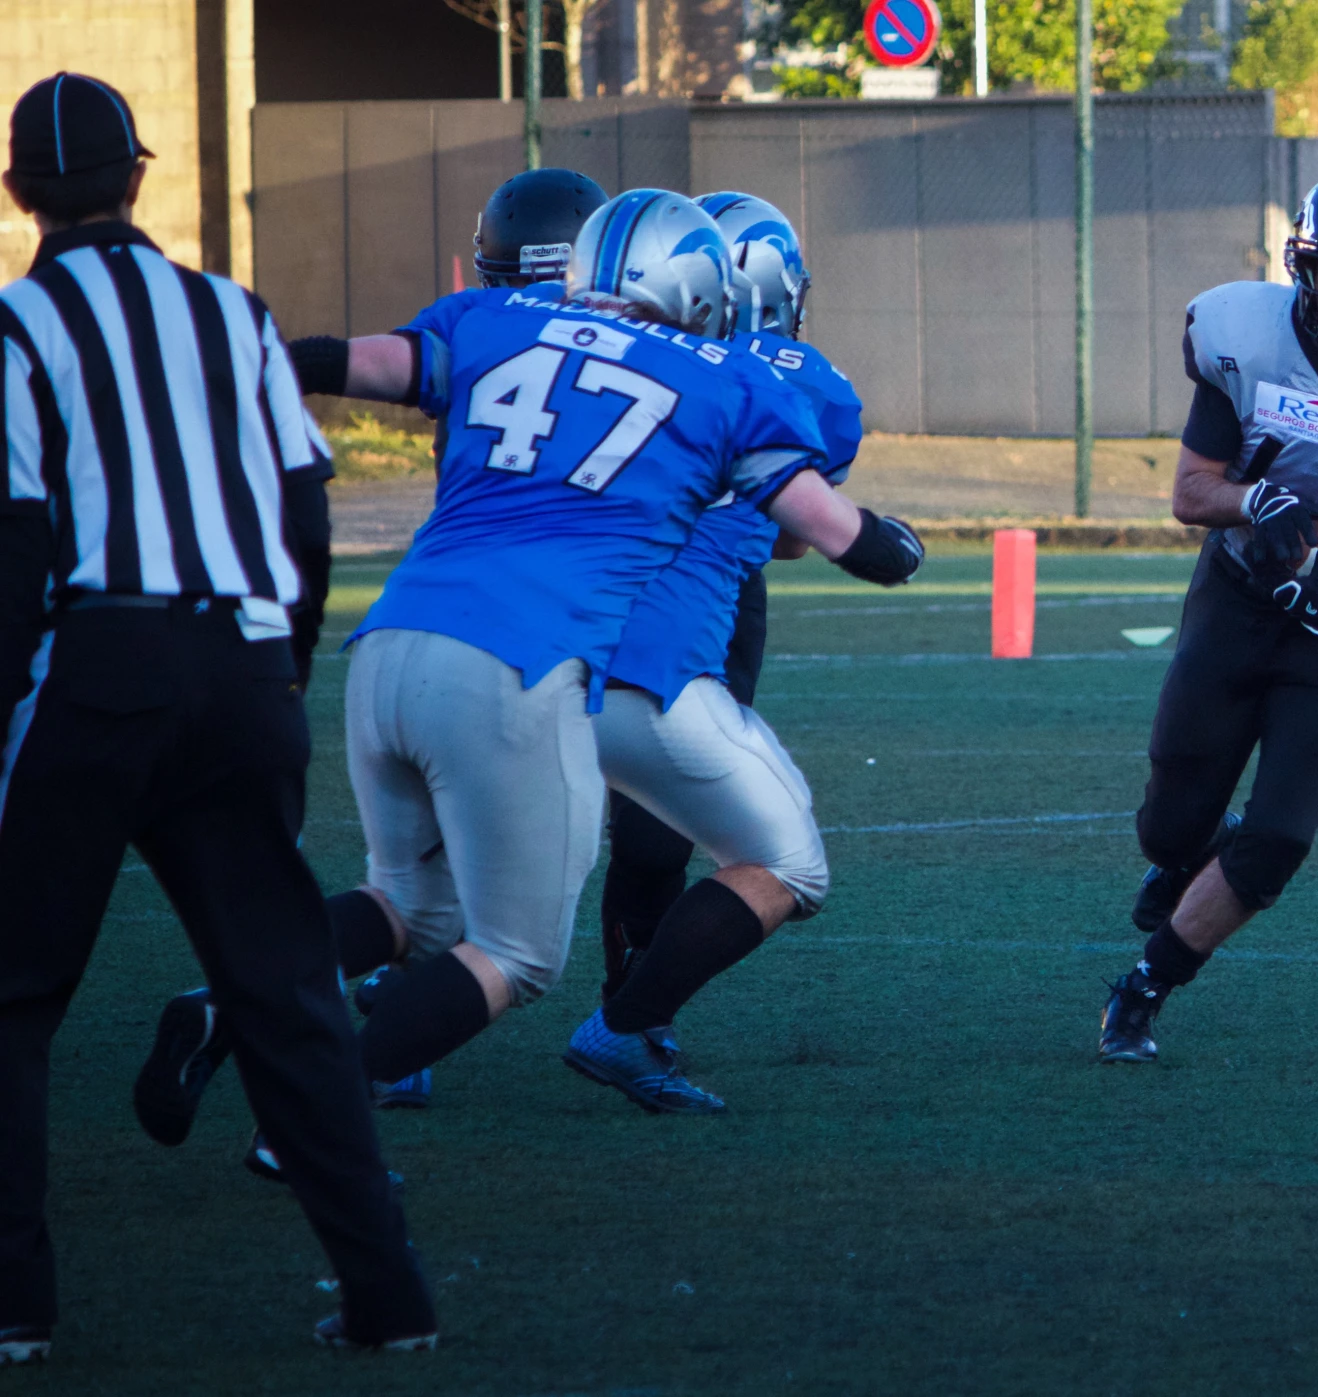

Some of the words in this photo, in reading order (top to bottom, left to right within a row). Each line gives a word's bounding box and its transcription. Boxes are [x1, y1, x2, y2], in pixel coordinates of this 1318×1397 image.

[531, 247, 559, 255] schutt
[465, 343, 682, 495] 47
[1256, 407, 1305, 429] SEGUROS
